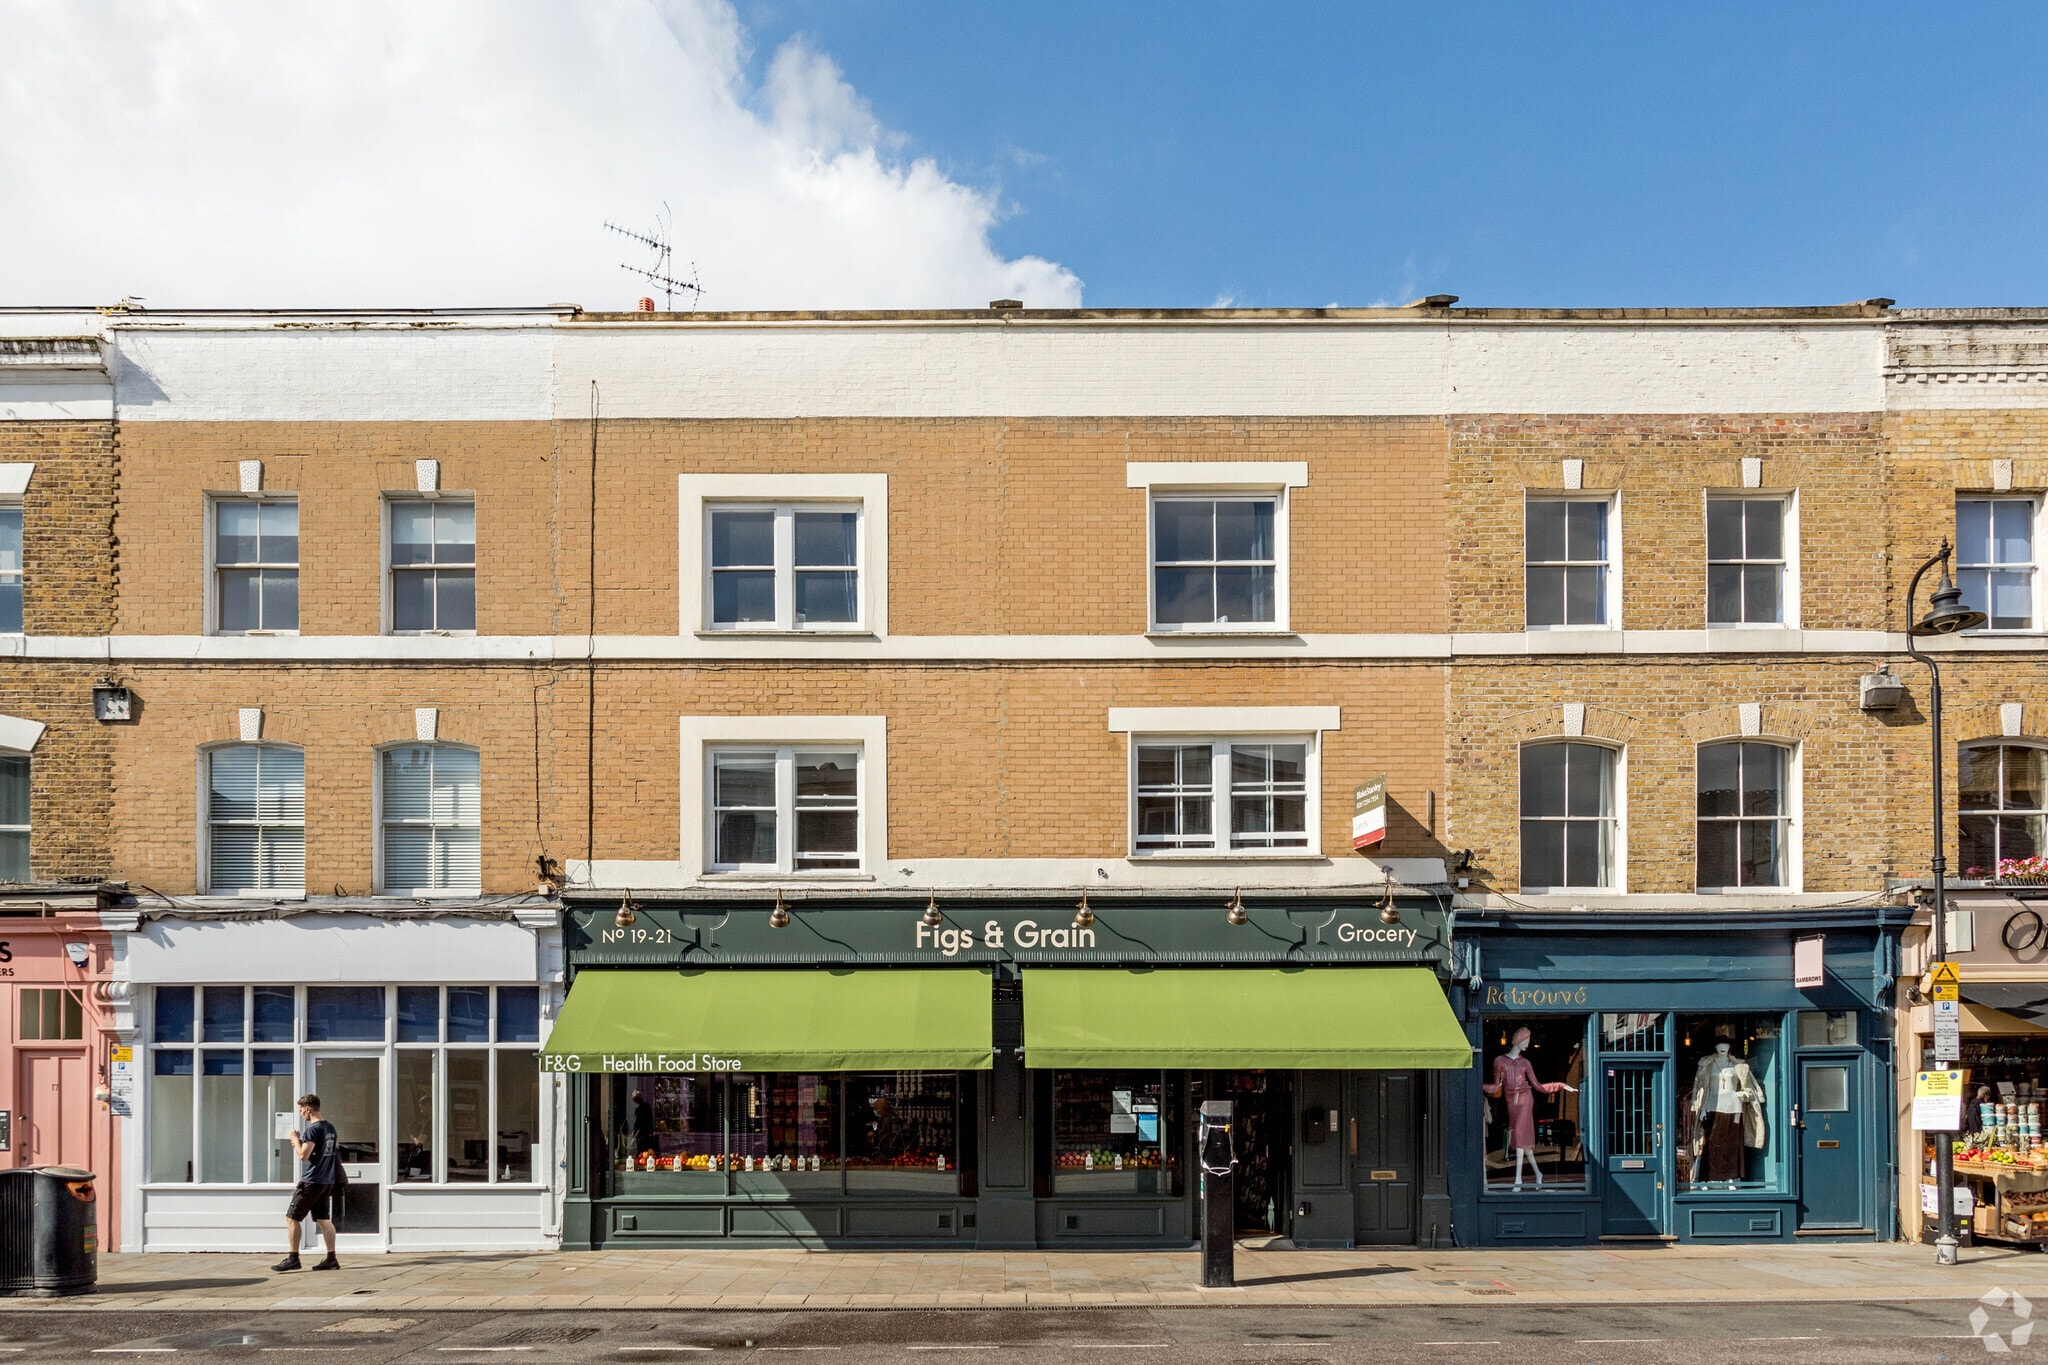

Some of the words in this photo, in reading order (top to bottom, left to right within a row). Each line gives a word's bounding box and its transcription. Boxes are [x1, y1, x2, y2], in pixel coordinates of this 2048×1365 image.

[630, 929, 671, 944] 19-21
[916, 920, 974, 957] Figs
[984, 920, 1004, 948] &
[1013, 920, 1096, 948] Grain
[1337, 923, 1418, 948] Grocery
[0, 968, 15, 976] RS
[1486, 986, 1588, 1006] Retrouvé
[545, 1054, 581, 1072] F&G
[602, 1053, 653, 1072] Health
[658, 1053, 697, 1072] Food
[702, 1053, 742, 1072] Store
